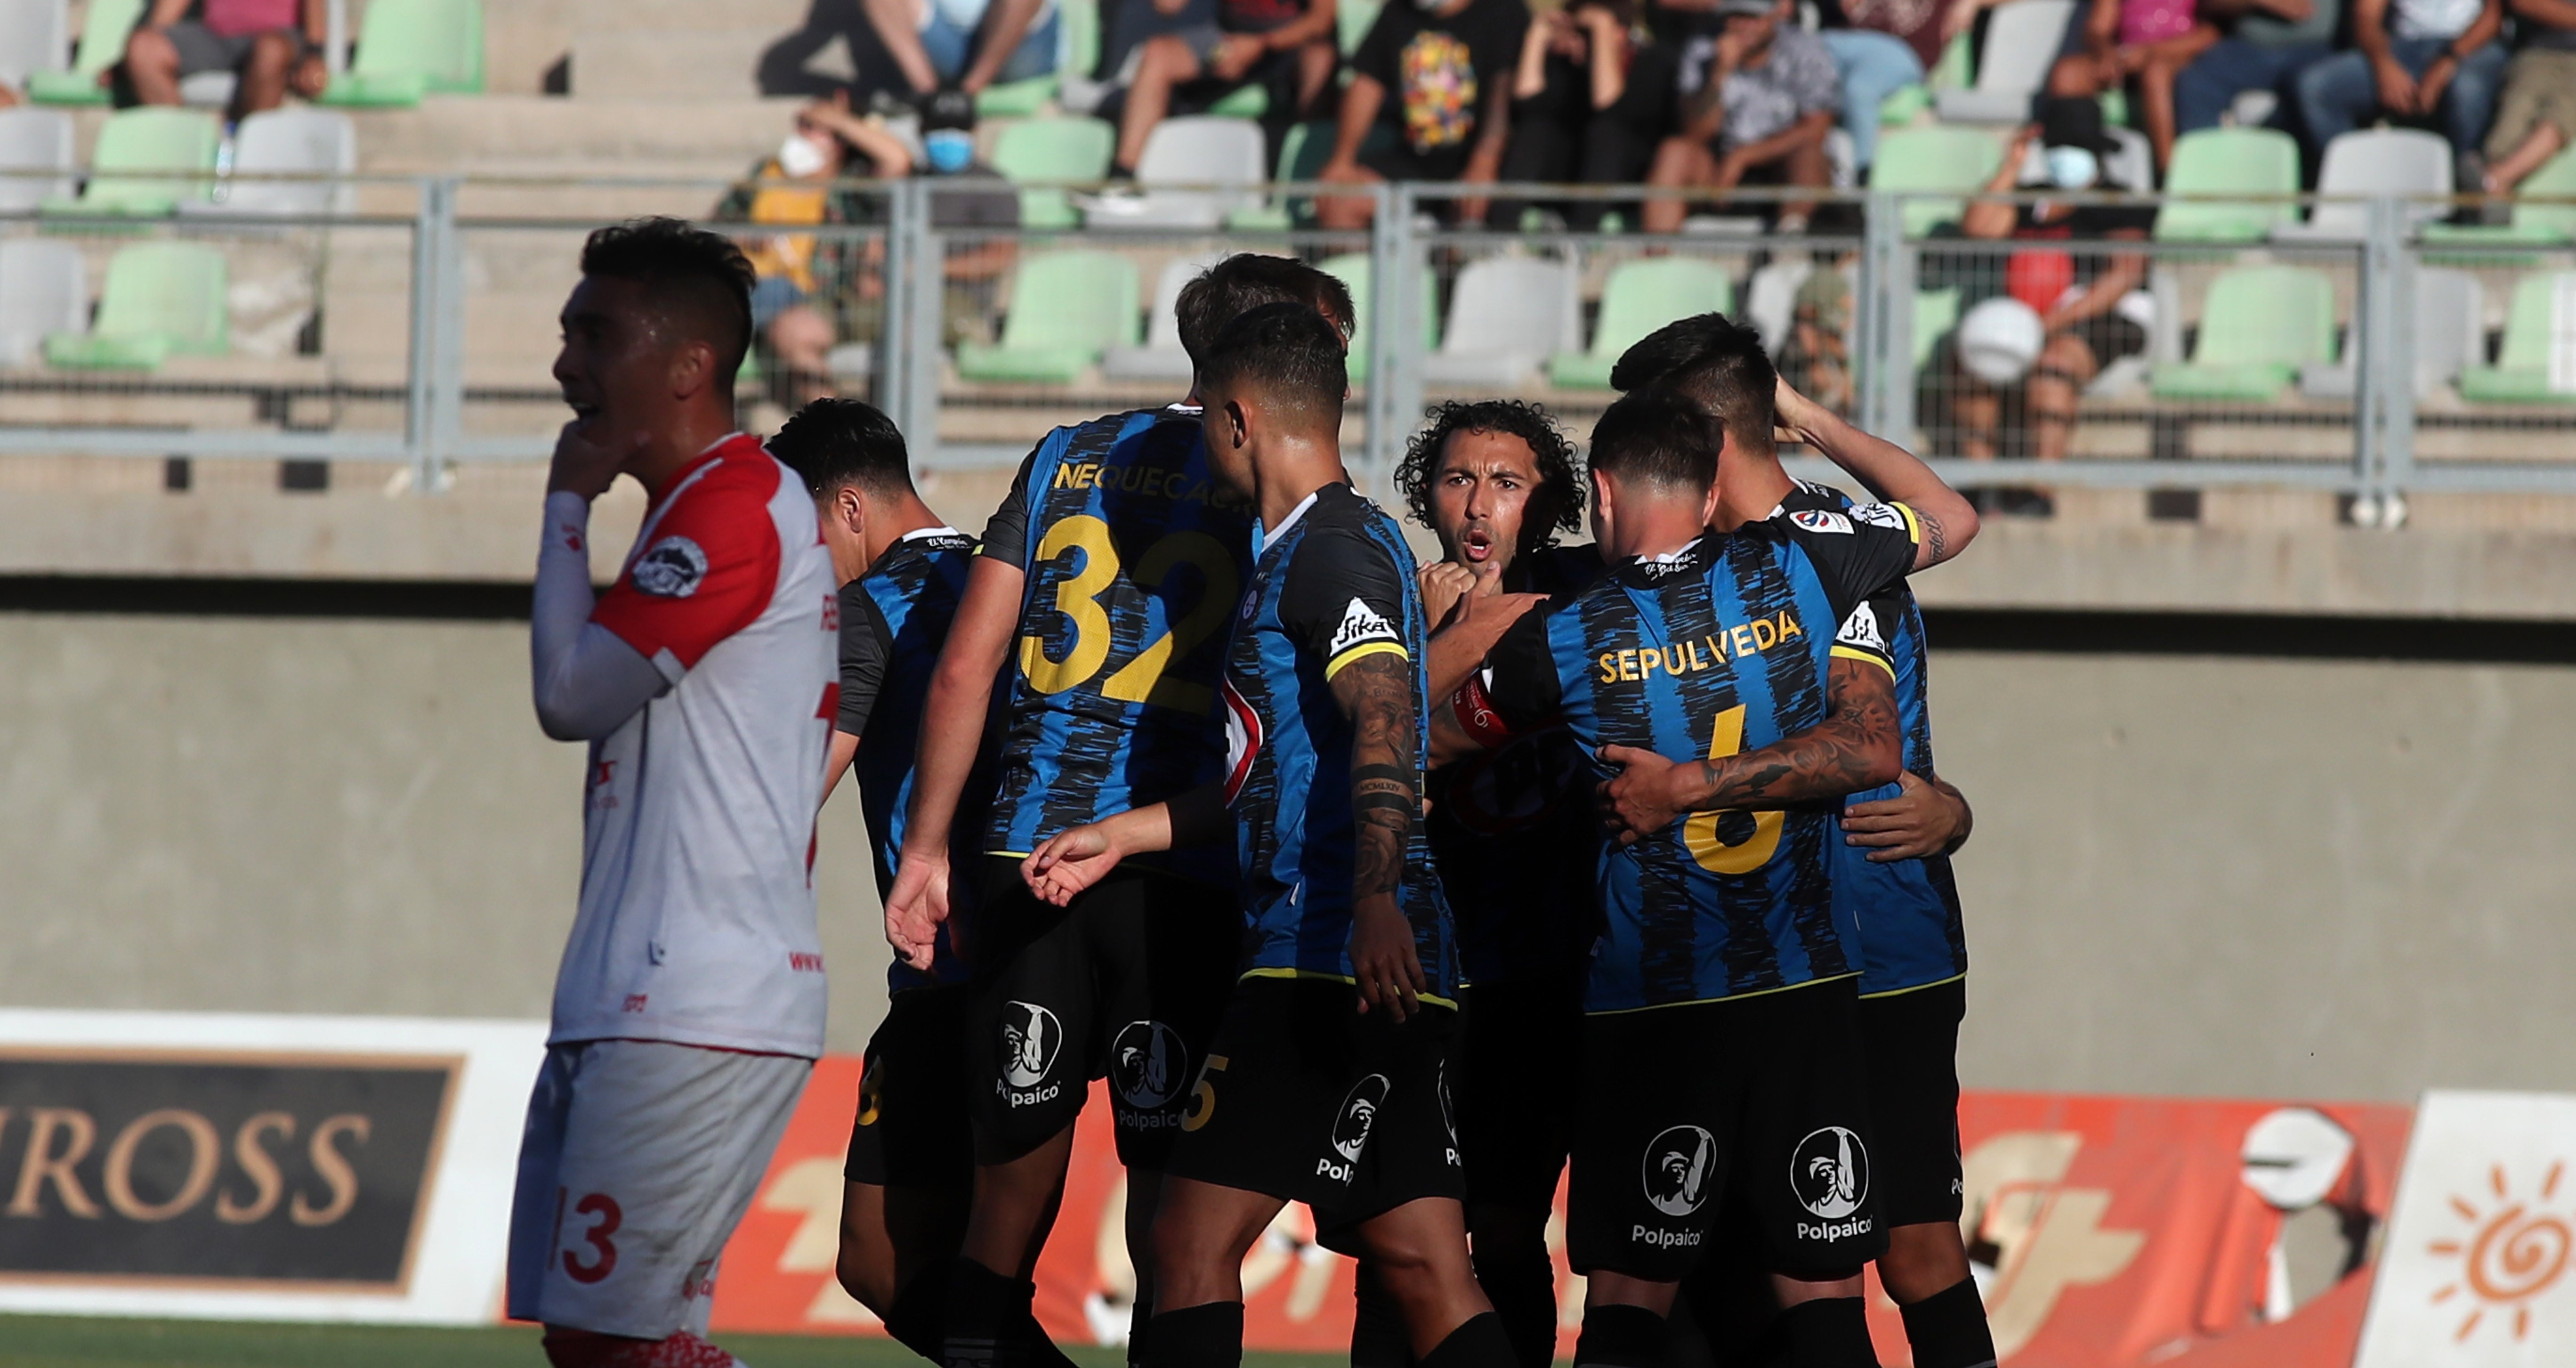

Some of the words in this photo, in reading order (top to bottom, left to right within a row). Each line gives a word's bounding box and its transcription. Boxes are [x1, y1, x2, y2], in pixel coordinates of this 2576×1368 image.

[1054, 462, 1252, 516] NEQUECA
[1019, 514, 1239, 716] 32
[1599, 610, 1802, 684] SEPULVEDA
[1683, 704, 1785, 875] 6
[1181, 1053, 1230, 1132] 5
[0, 1106, 373, 1226] ROSS
[1631, 1224, 1702, 1250] Polpaico
[1796, 1216, 1873, 1244] Polpaico
